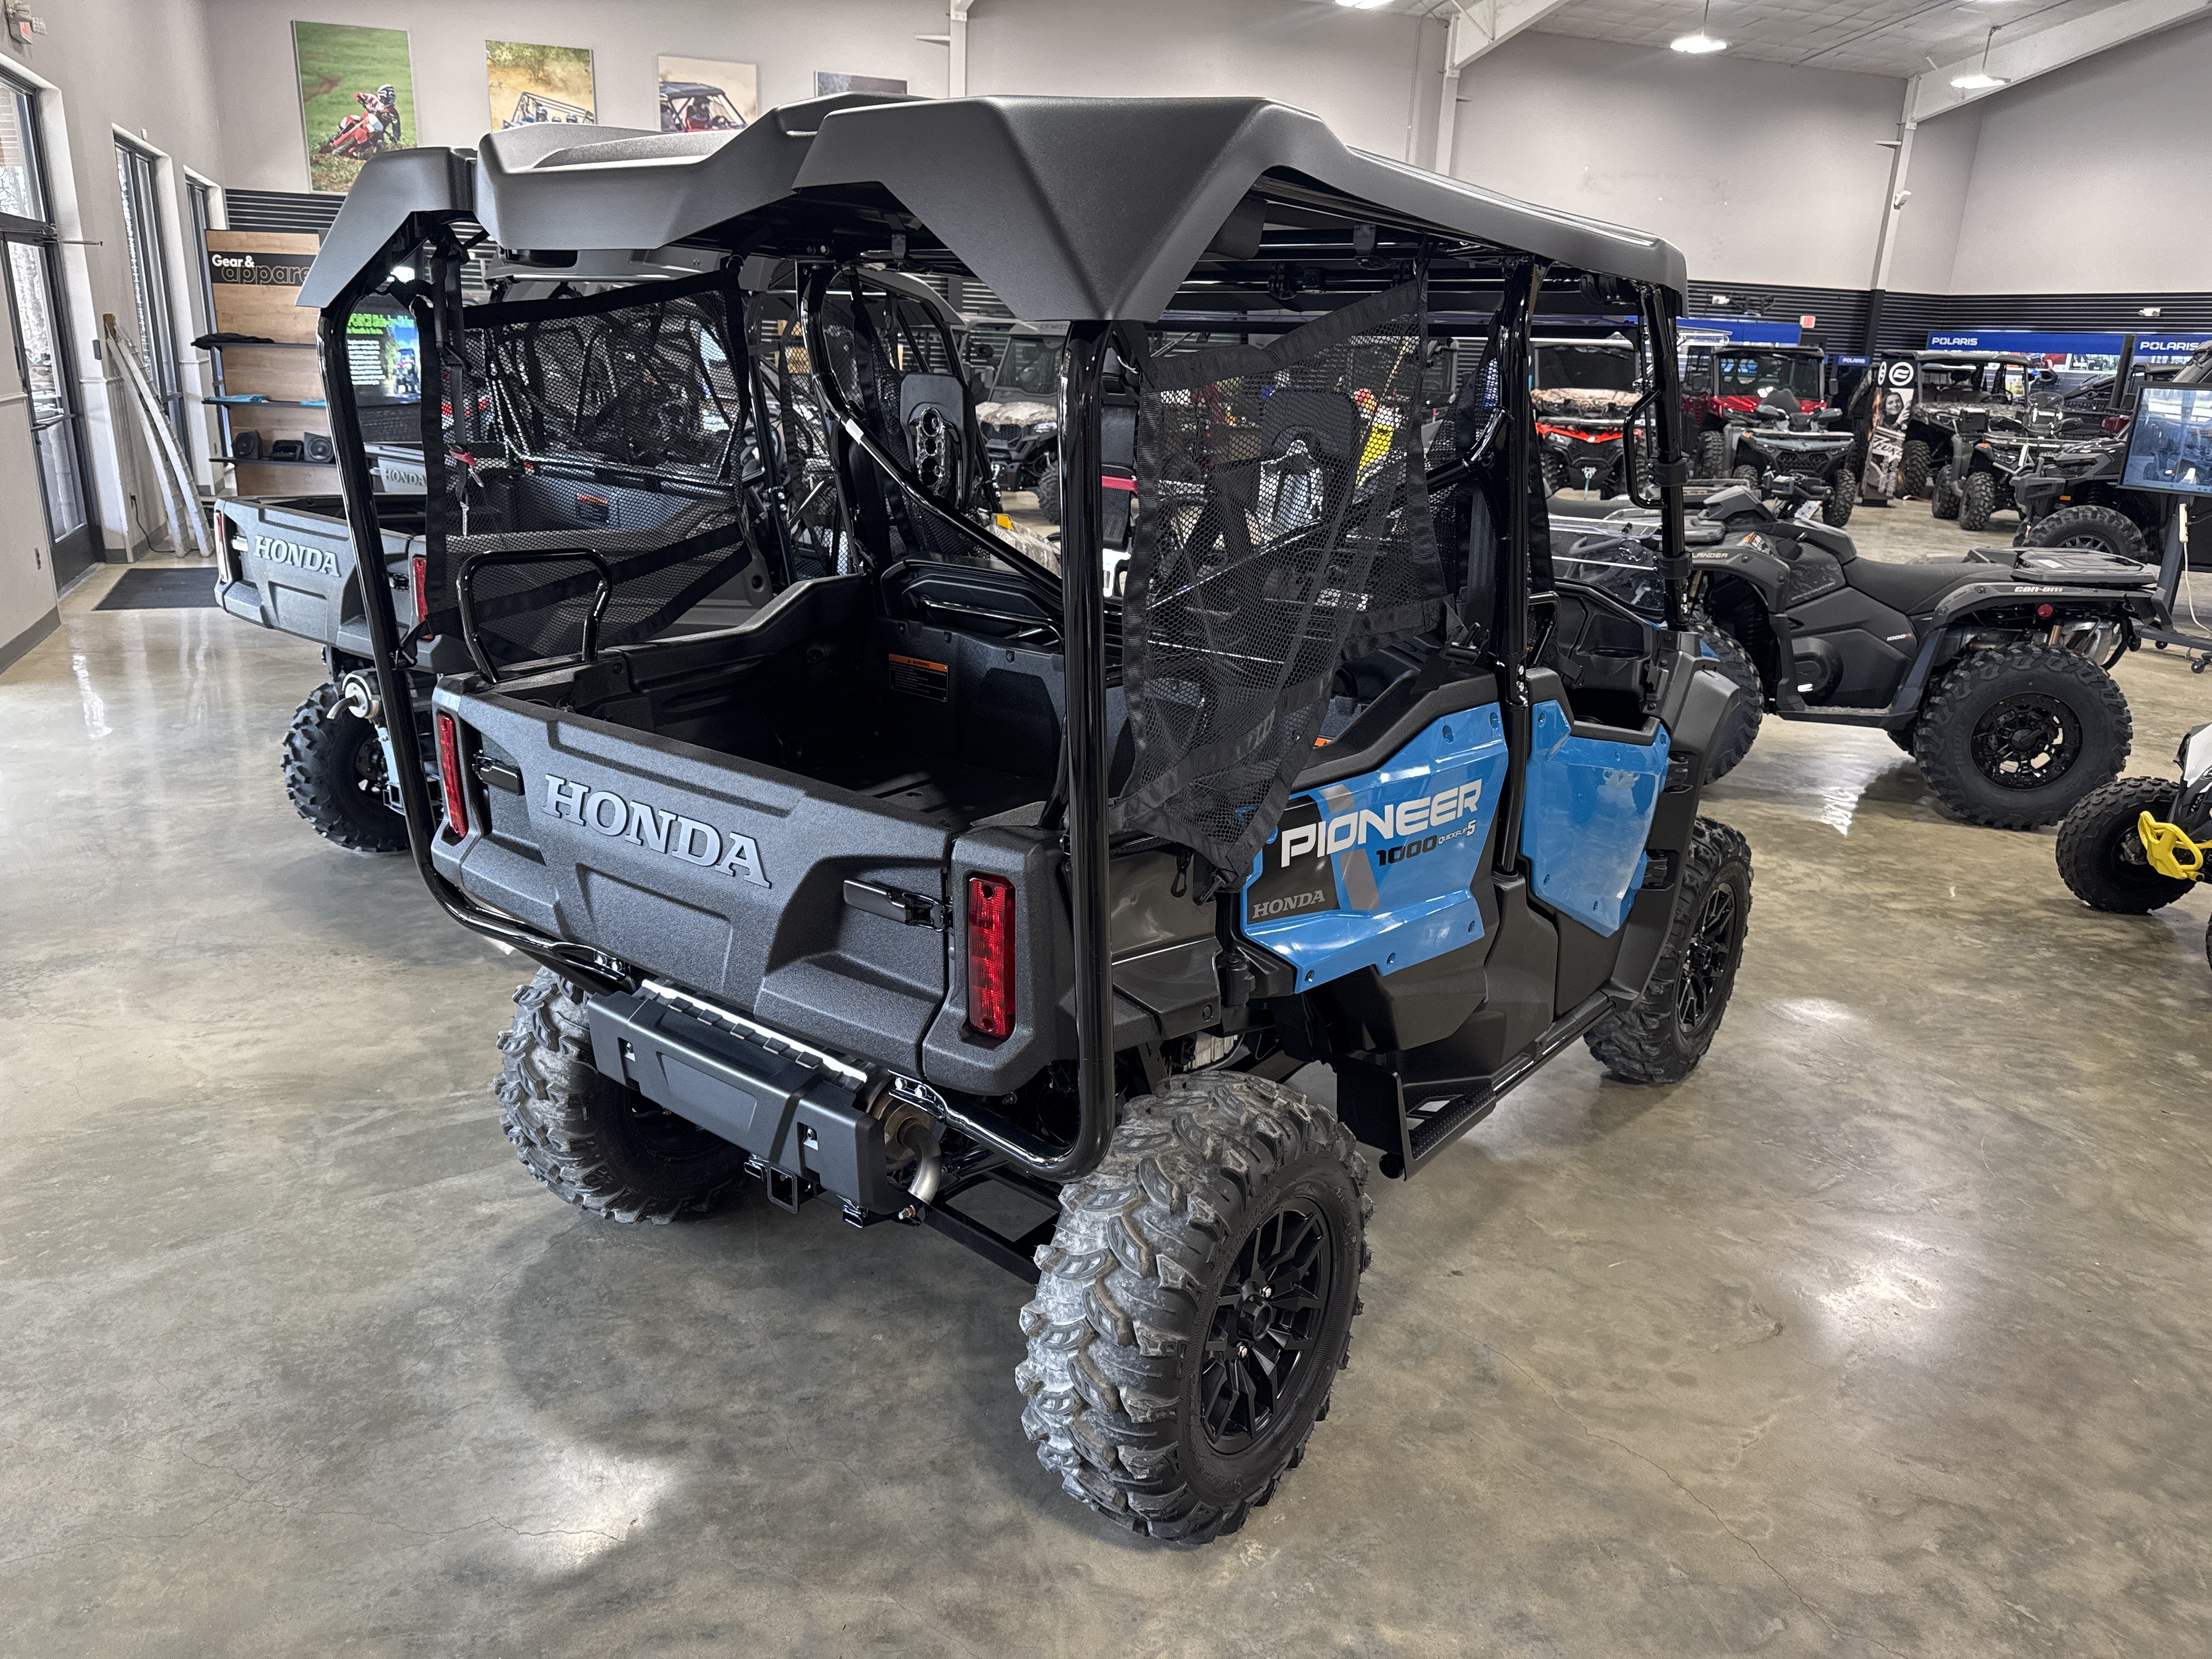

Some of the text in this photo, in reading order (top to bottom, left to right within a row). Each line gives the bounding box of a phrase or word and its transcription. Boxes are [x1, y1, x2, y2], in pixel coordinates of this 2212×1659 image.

[212, 254, 255, 268] Gear &
[221, 266, 311, 285] appare
[1932, 337, 1978, 346] POLARIS
[2140, 342, 2199, 351] POLARIS
[383, 468, 427, 487] HONDA
[253, 535, 342, 577] HONDA
[540, 774, 772, 889] HONDA
[1281, 778, 1482, 868] PIONEER
[1376, 835, 1437, 866] 1000
[1252, 889, 1325, 918] HONDA
